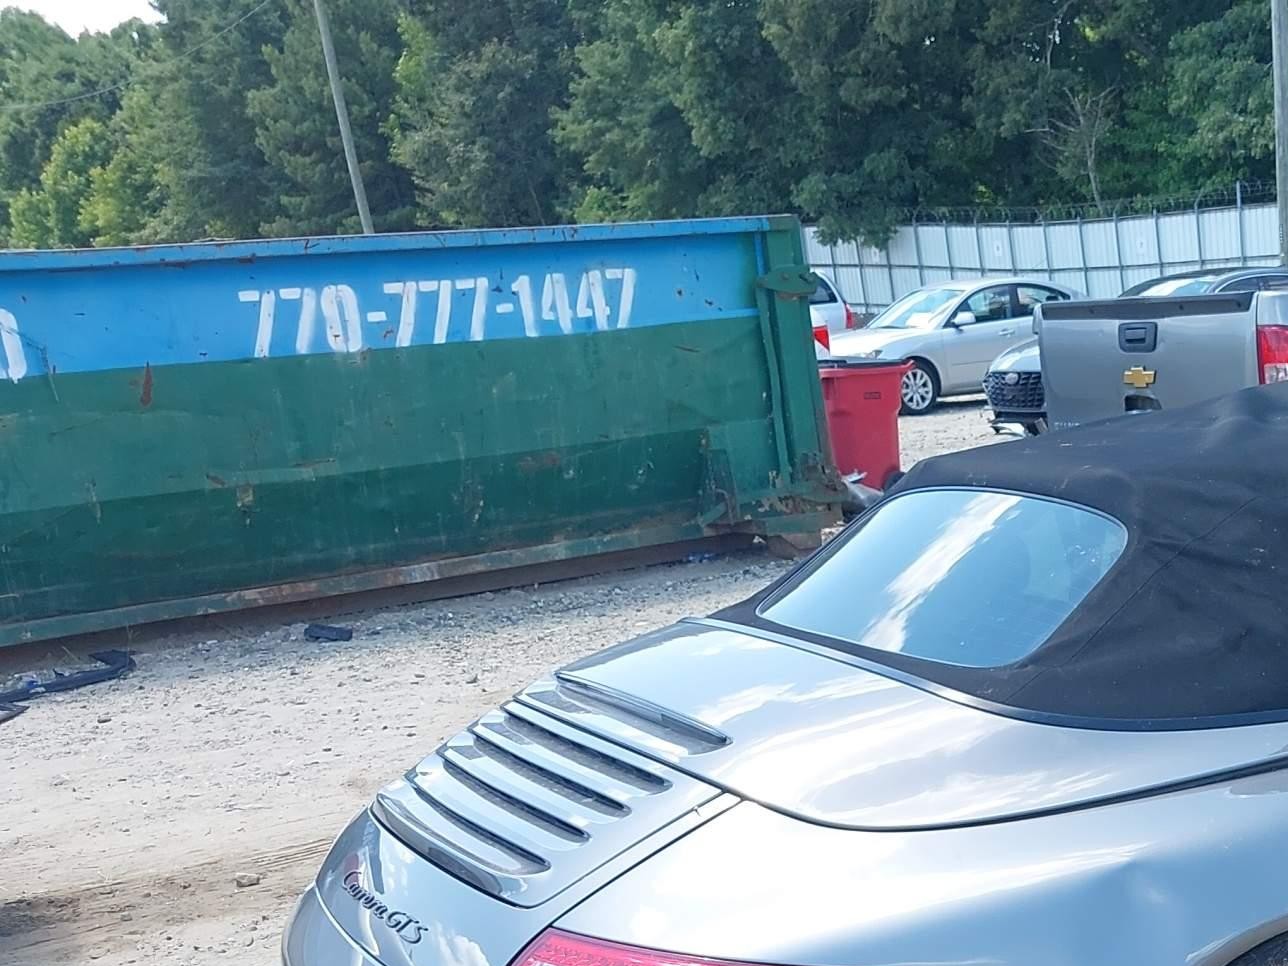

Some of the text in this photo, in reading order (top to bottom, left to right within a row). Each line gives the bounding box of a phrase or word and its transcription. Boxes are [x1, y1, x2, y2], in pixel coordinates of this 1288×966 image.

[238, 268, 636, 358] 770-777-1447
[342, 871, 429, 944] Carrera GTS
